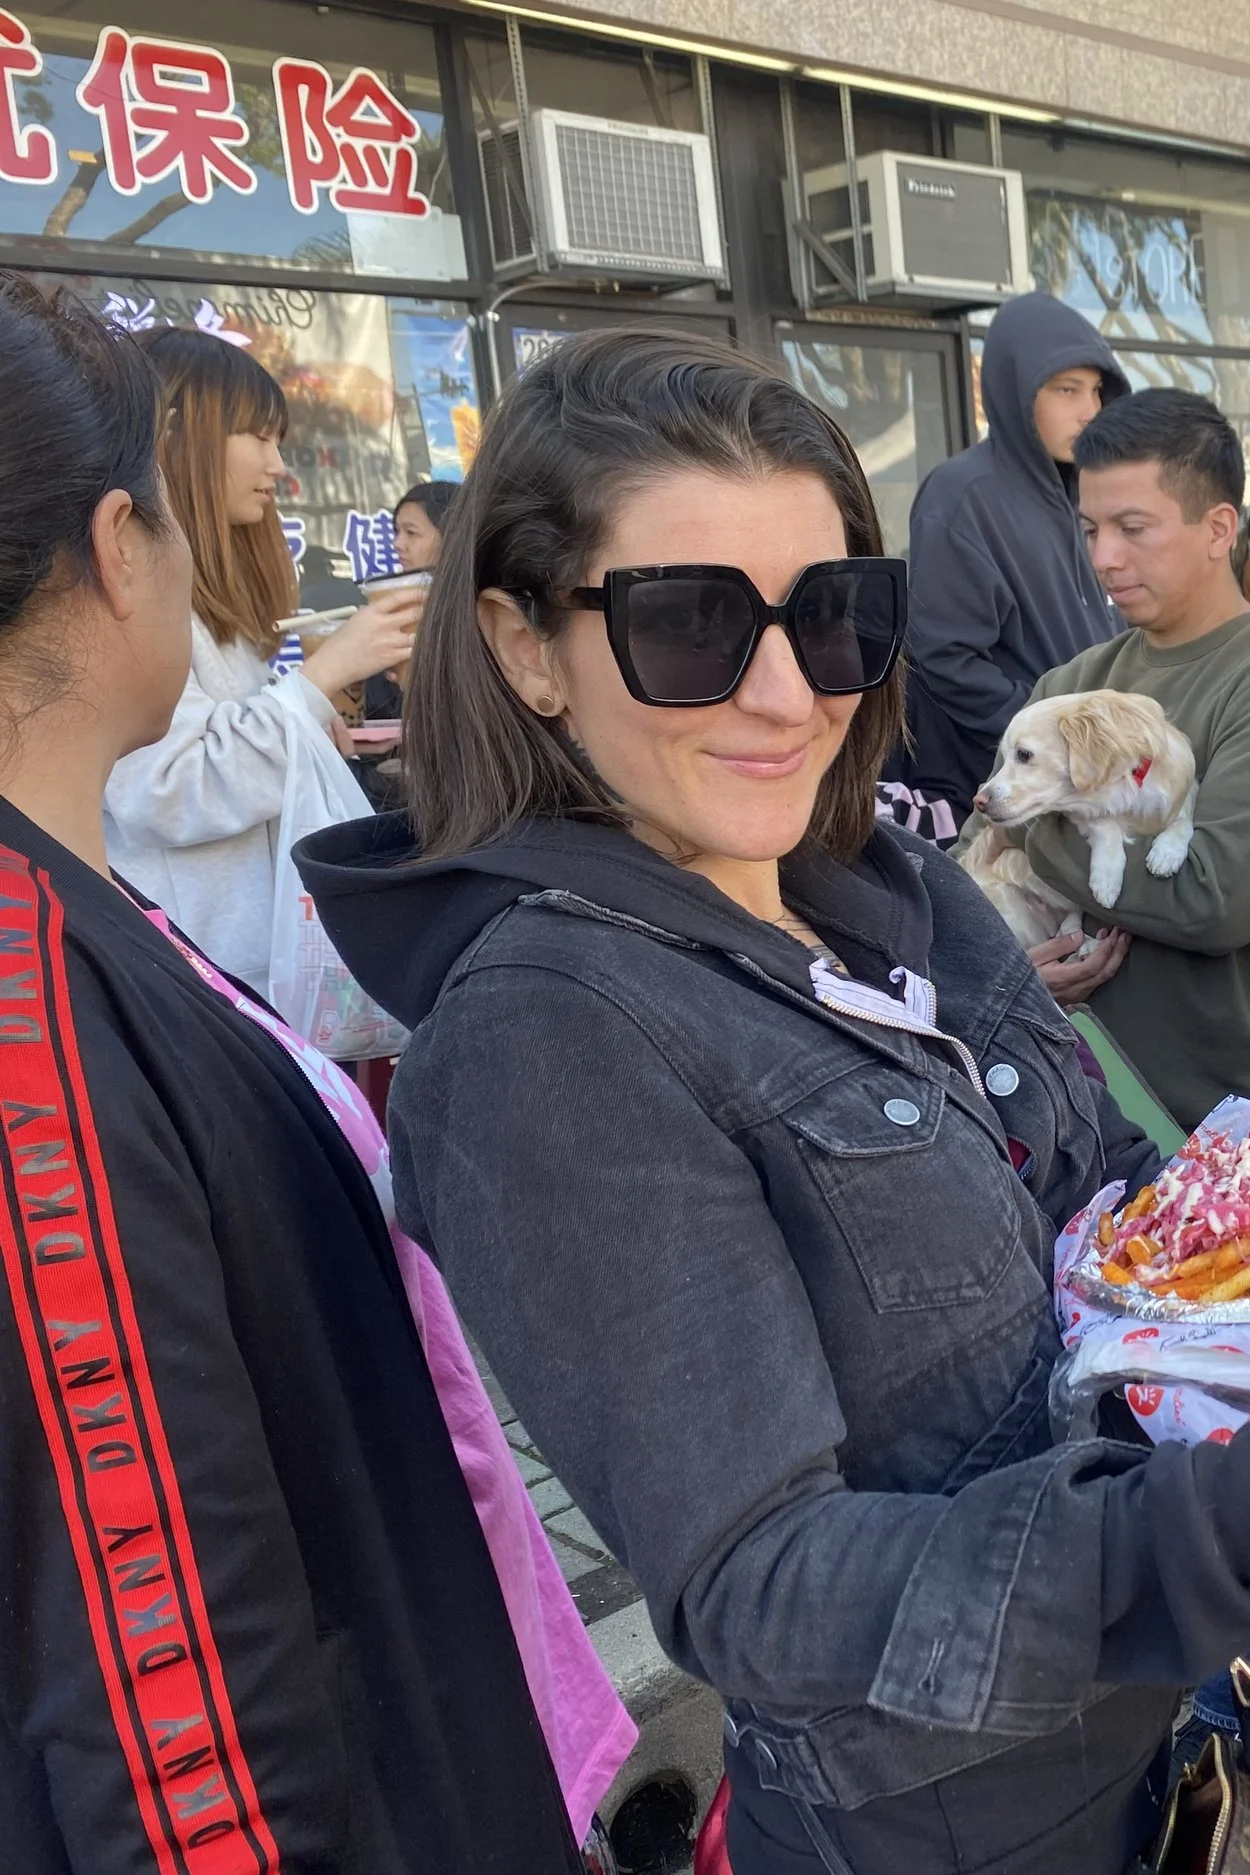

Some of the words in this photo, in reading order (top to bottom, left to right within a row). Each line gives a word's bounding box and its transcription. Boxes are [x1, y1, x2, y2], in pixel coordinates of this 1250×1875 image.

[3, 1100, 87, 1266] DKNY
[47, 1319, 137, 1474] DKNY
[102, 1523, 188, 1677] DKNY
[151, 1712, 235, 1850] DKNY
